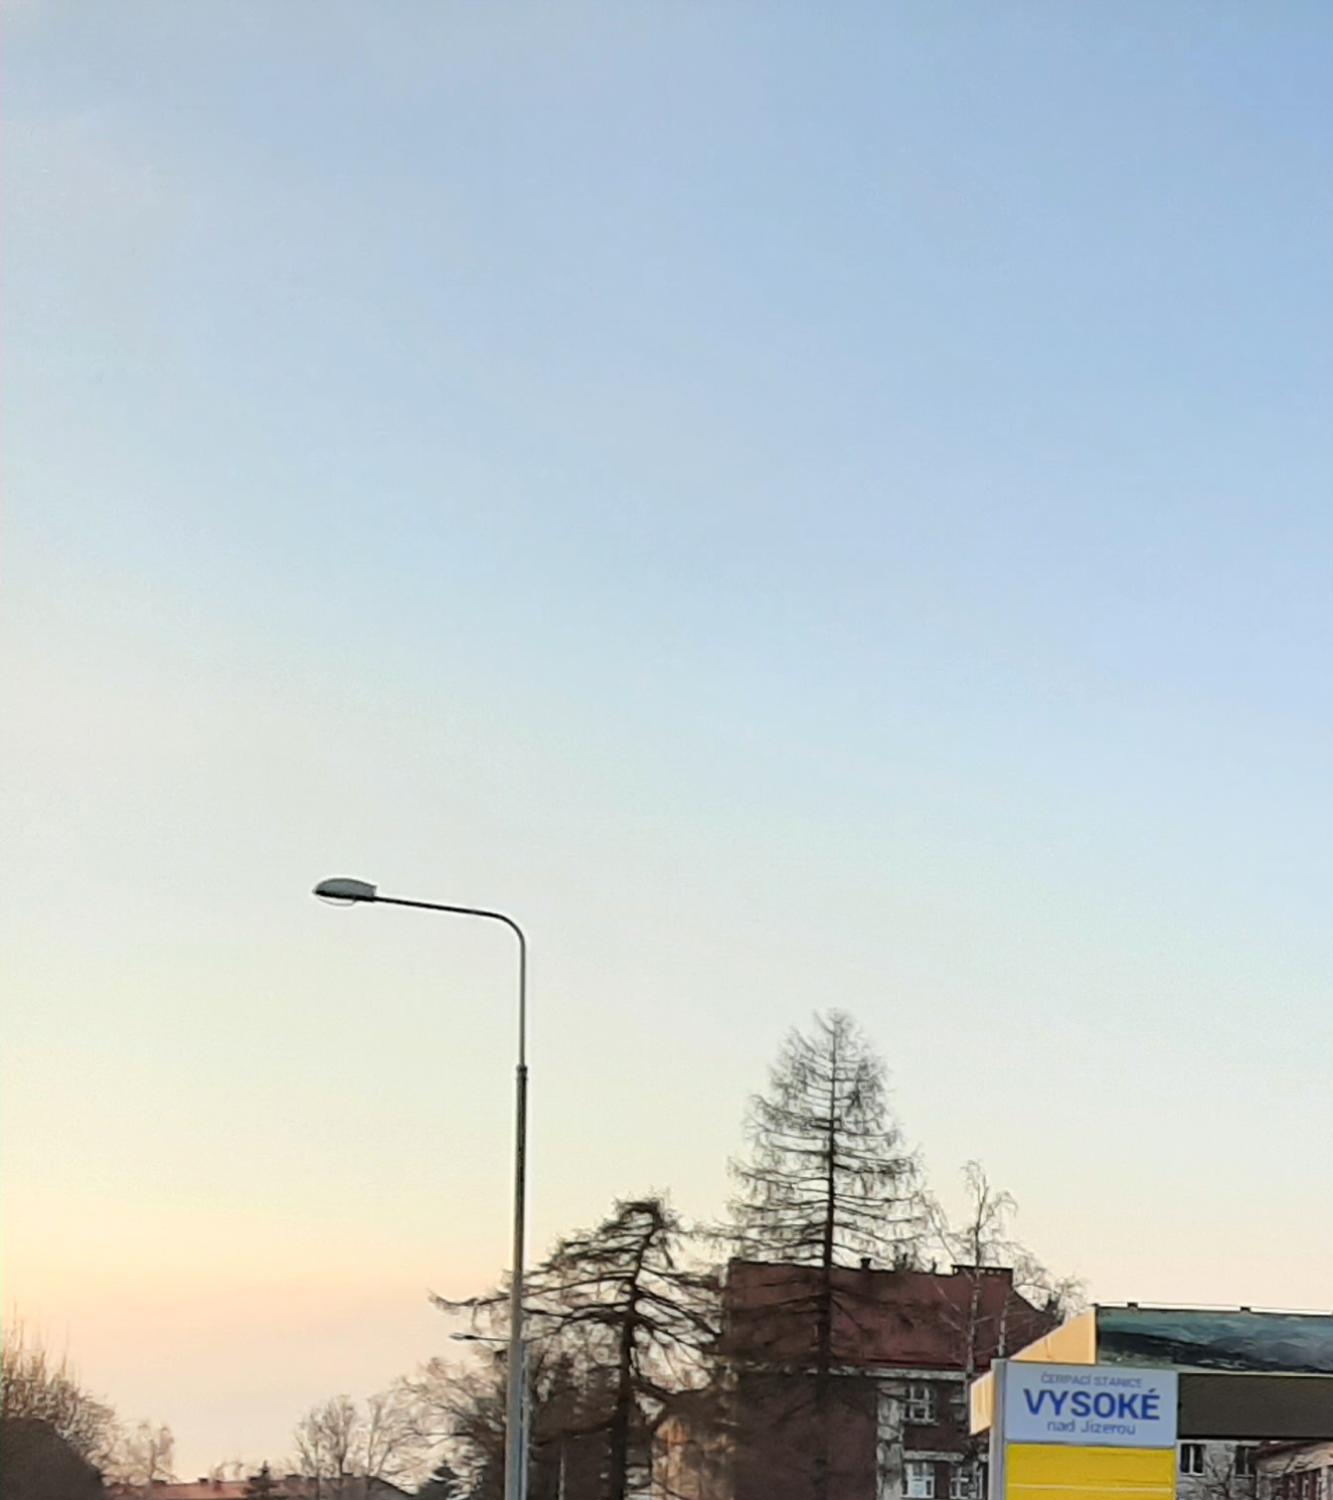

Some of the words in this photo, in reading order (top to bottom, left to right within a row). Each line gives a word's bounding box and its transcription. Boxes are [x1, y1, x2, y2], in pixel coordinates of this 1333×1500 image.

[1040, 1371, 1092, 1385] ČERPACÍ
[1093, 1376, 1143, 1388] STANICE
[1023, 1388, 1160, 1420] VYSOKÉ
[1047, 1420, 1076, 1433] nad
[1080, 1421, 1136, 1435] Jizerou
